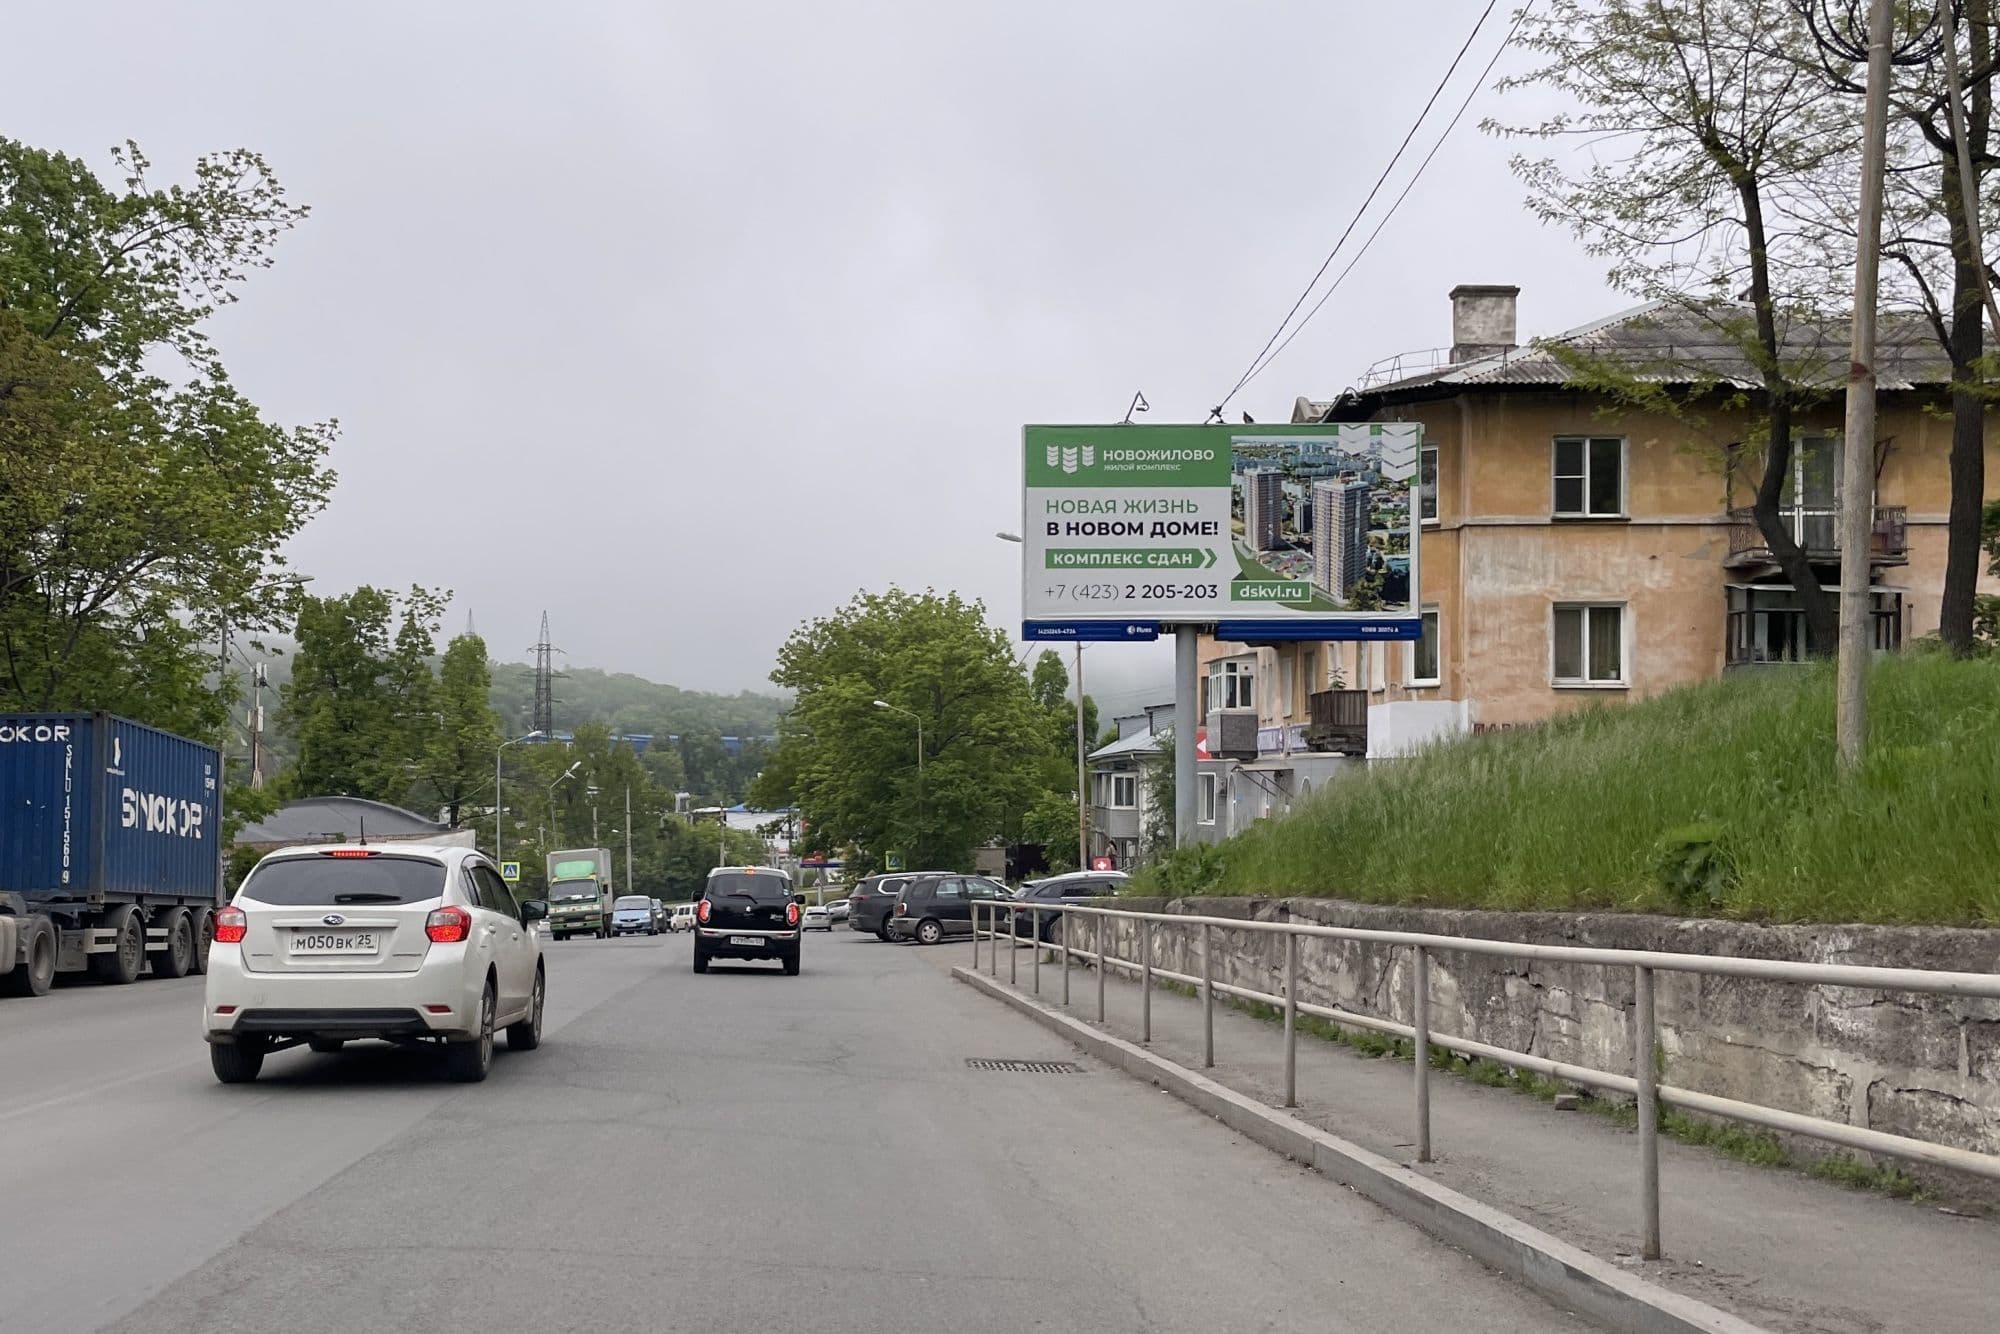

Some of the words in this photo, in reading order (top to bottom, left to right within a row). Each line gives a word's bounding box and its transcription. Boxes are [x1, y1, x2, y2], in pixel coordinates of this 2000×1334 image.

[1103, 449, 1215, 461] НОВОЖИЛОВО
[1103, 463, 1135, 471] ЖИЛОЙ
[1046, 500, 1117, 514] НОВАЯ
[1123, 500, 1199, 514] ЖИЗНЬ
[1046, 522, 1060, 536] В
[1065, 522, 1144, 536] НОВОМ
[1150, 521, 1219, 538] ДОМЕ!
[1053, 553, 1143, 565] КОМПЛЕКС
[1147, 553, 1193, 566] СДАН
[1045, 584, 1066, 599] +7
[1071, 584, 1120, 601] (423)
[1125, 584, 1136, 599] 2
[1141, 584, 1218, 599] 205-203
[1240, 585, 1302, 598] dskvl.ru
[121, 787, 202, 839] SINOKOR
